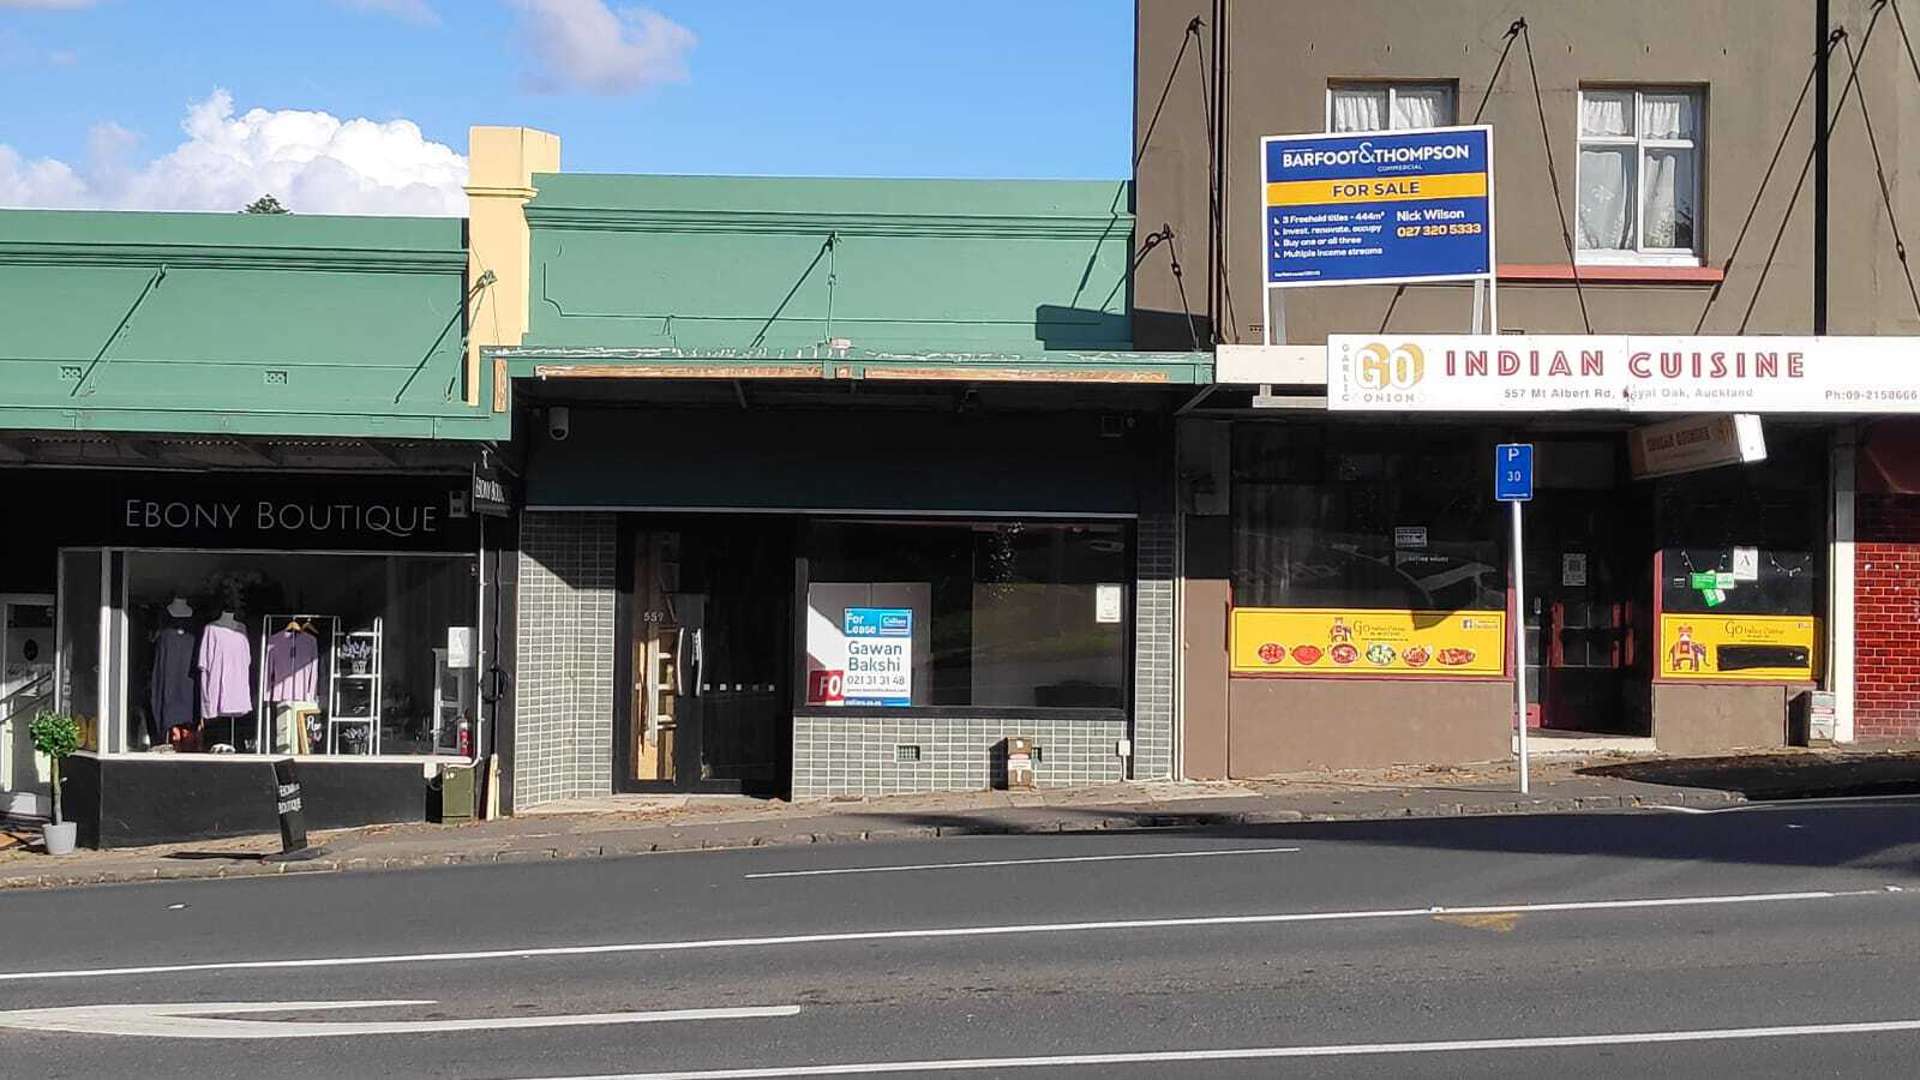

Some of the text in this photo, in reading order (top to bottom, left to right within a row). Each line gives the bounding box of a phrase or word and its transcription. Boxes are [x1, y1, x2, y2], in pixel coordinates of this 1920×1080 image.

[1377, 164, 1424, 173] COMMERCIAL
[1333, 181, 1420, 197] FOR SALE
[1290, 214, 1327, 223] Freehold
[1396, 209, 1465, 221] Nick Wilson
[1352, 225, 1382, 233] occupy
[1397, 223, 1482, 237] 027 320 5333
[1283, 239, 1300, 248] Buy
[1339, 236, 1362, 244] three
[1283, 247, 1383, 258] Multiple income streams
[1355, 342, 1425, 391] GO
[1446, 350, 1804, 378] INDIAN CUISINE
[1363, 393, 1415, 403] ONION
[1504, 388, 1526, 399] 557
[1531, 388, 1546, 399] Mt
[1551, 387, 1589, 399] Albert
[1595, 388, 1616, 400] Rd,
[1622, 385, 1656, 401] oyal
[1695, 387, 1753, 398] Auckland
[1508, 447, 1519, 462] P
[1507, 470, 1521, 482] 30
[126, 500, 437, 536] EBONY BOUTIQUE
[847, 612, 865, 624] For
[846, 623, 877, 635] Lease
[848, 640, 902, 656] Gawan
[848, 656, 901, 672] Bakshi
[847, 674, 905, 686] 021 31 31 48
